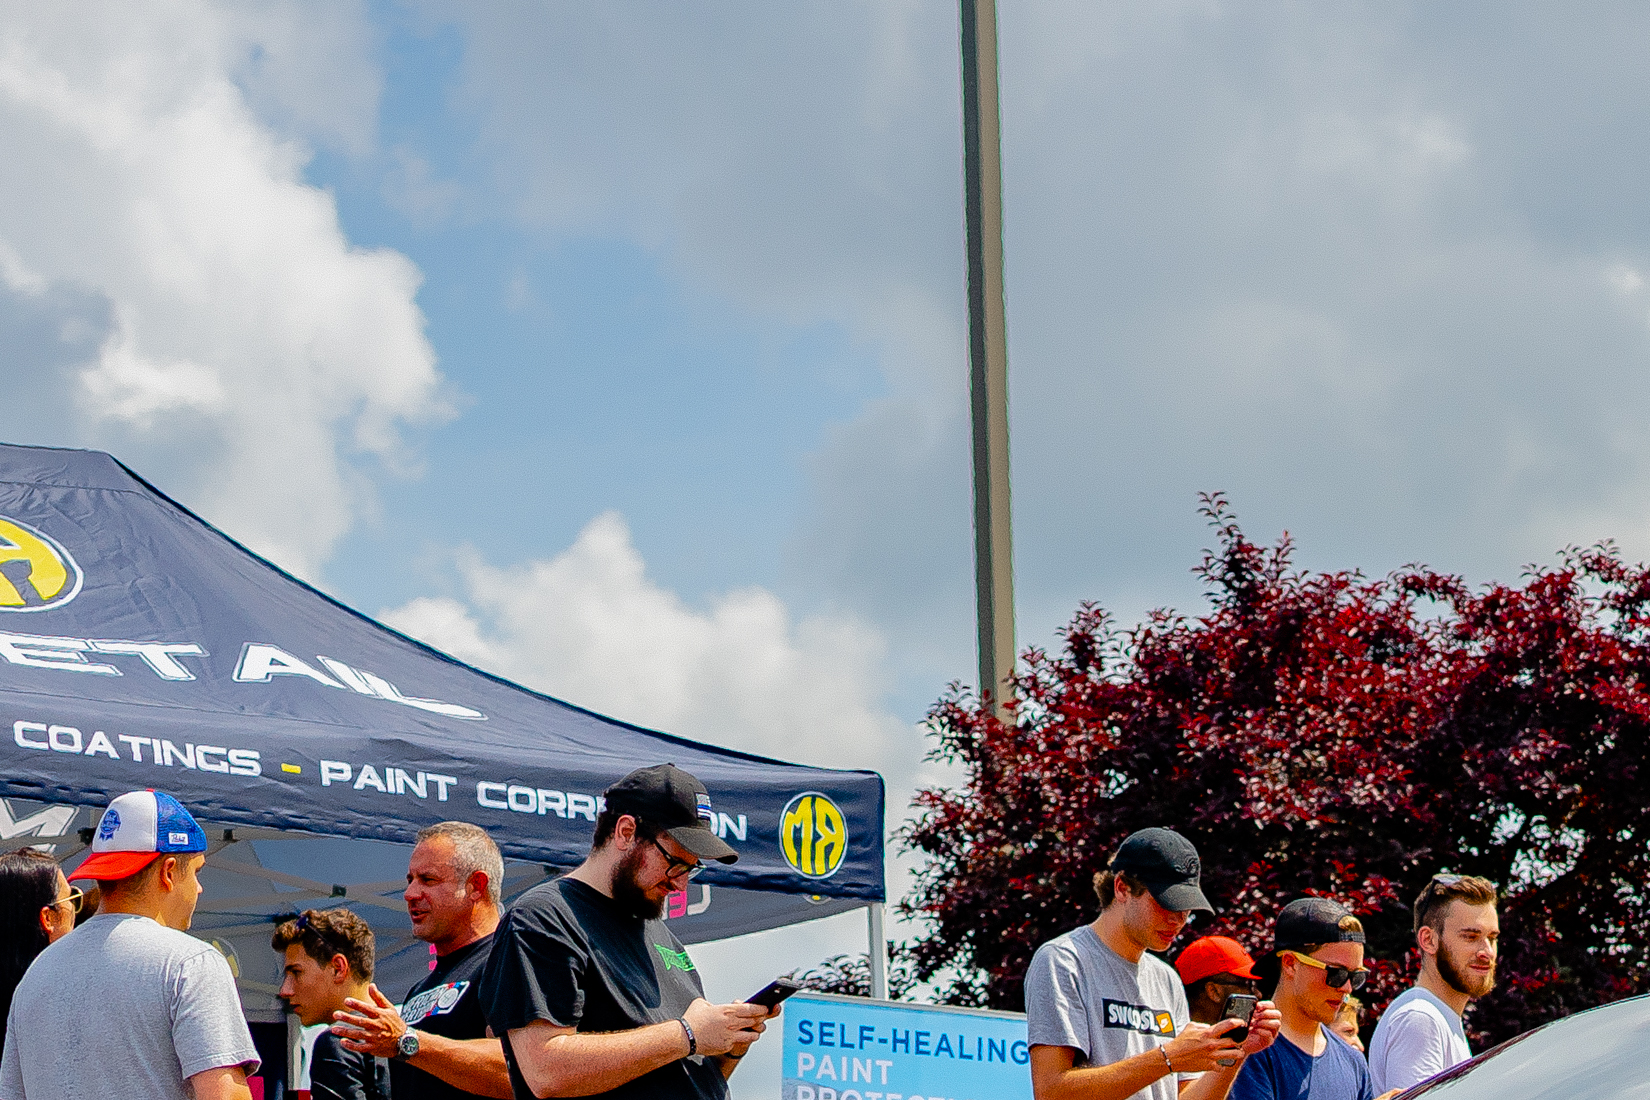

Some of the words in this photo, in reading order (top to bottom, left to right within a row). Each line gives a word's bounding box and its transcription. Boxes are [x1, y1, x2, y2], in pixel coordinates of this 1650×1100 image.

[13, 720, 262, 777] COATINGS
[320, 760, 458, 802] PAINT
[476, 780, 748, 842] CORRN
[797, 1020, 1029, 1066] SELF-HEALING
[796, 1053, 893, 1086] PAINT
